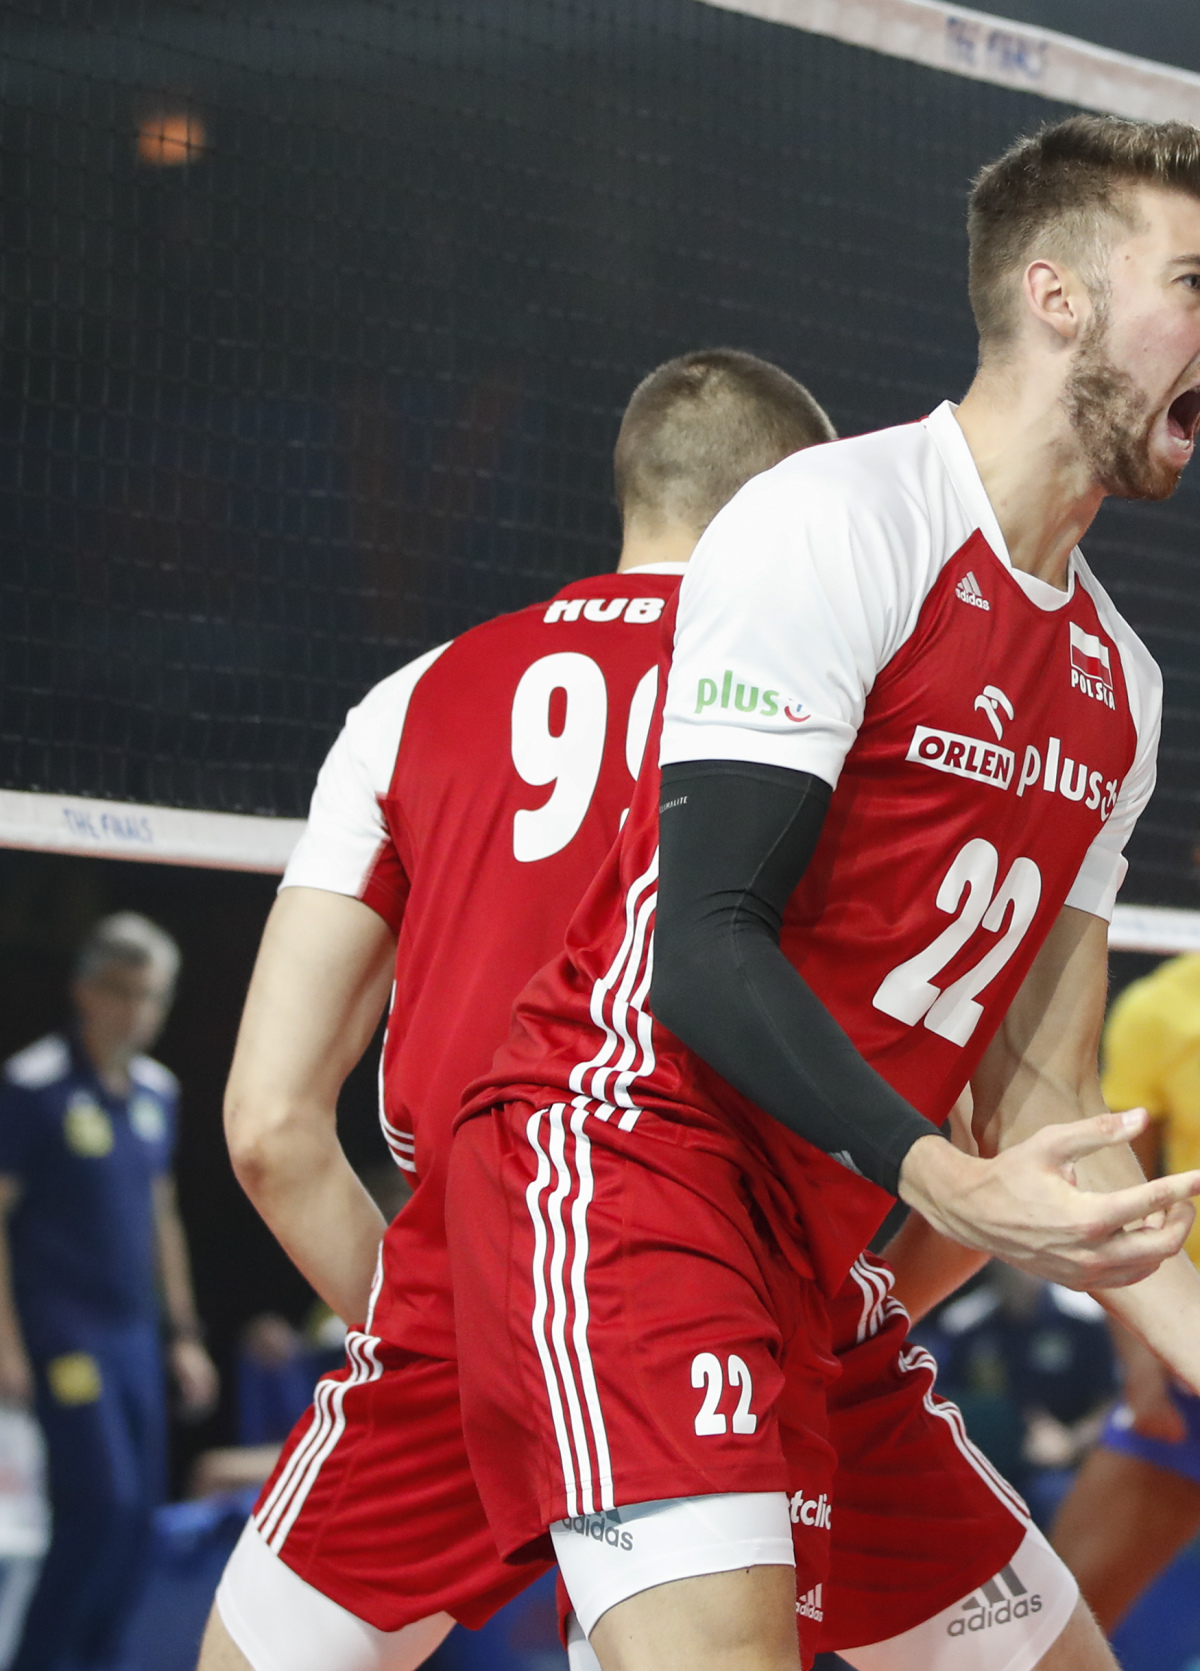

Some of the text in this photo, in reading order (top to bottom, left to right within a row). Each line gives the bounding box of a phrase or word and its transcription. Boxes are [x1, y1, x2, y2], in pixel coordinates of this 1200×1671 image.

[543, 597, 666, 624] HUB
[955, 588, 990, 611] adidas
[694, 669, 780, 715] plus
[1071, 669, 1116, 711] POLSKA
[917, 735, 1012, 784] ORLEN
[1016, 736, 1103, 811] plus
[872, 838, 1042, 1048] 22
[691, 1352, 757, 1436] 22
[562, 1516, 634, 1551] adidas
[946, 1594, 1043, 1637] adidas
